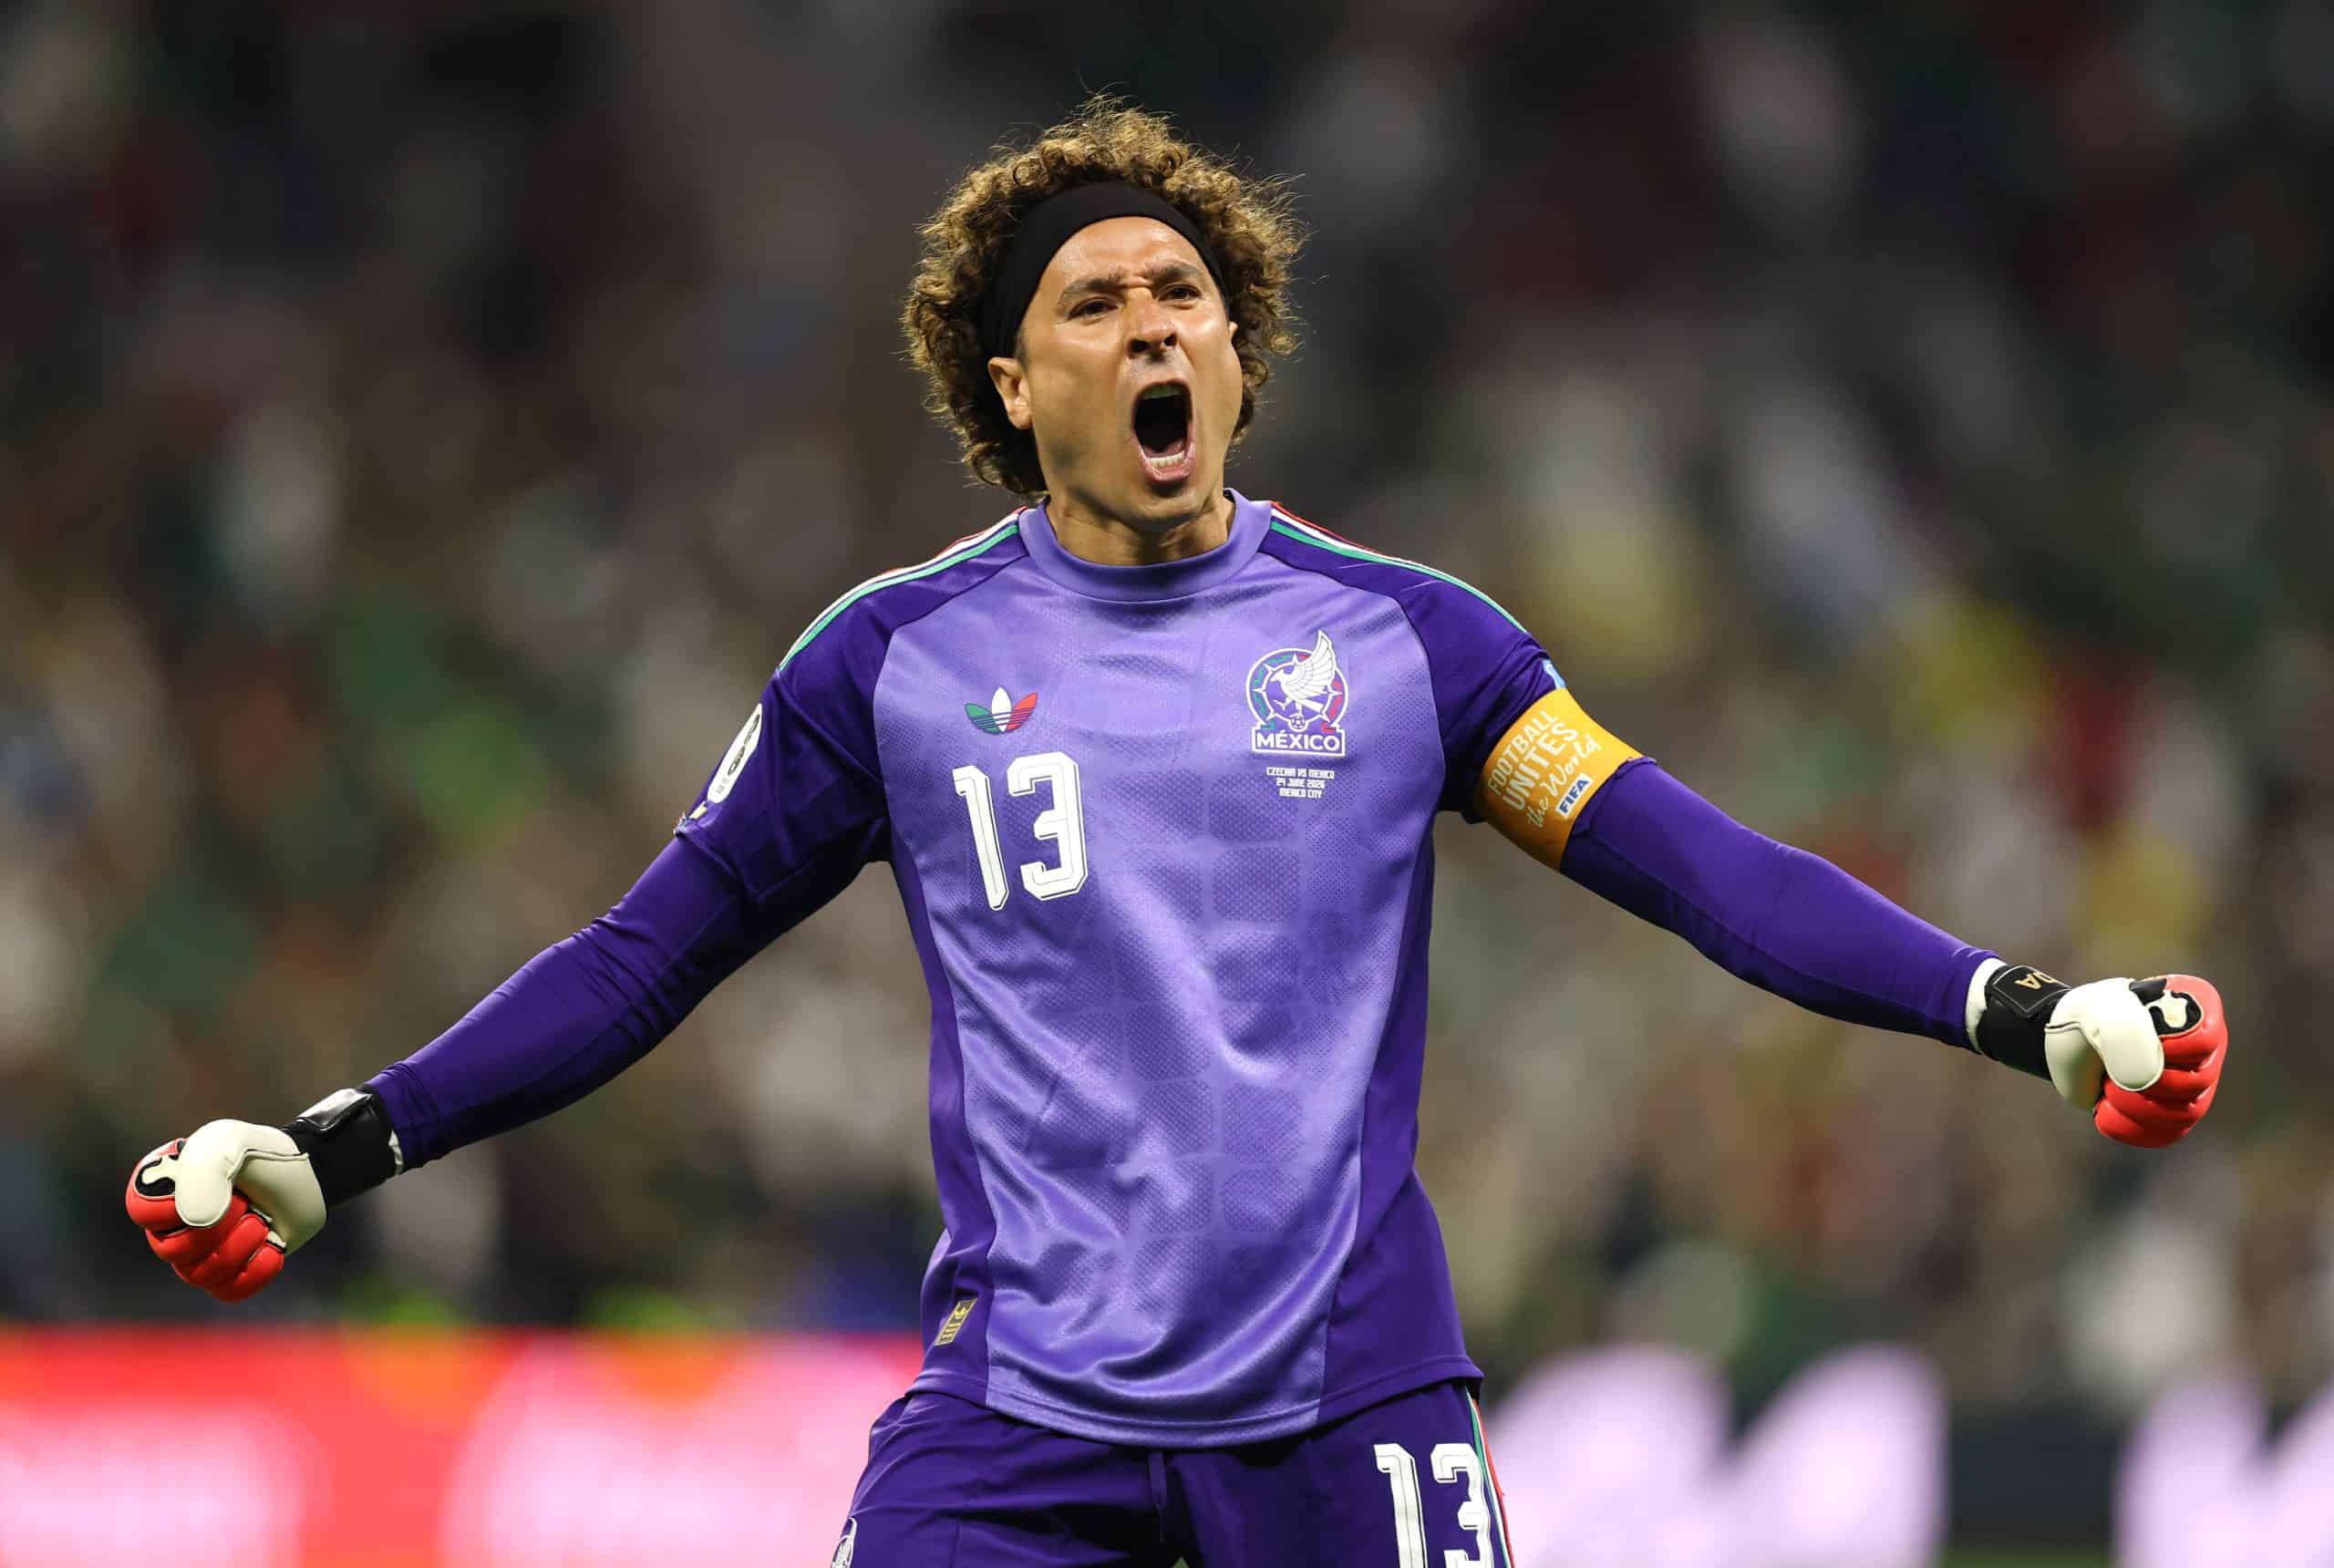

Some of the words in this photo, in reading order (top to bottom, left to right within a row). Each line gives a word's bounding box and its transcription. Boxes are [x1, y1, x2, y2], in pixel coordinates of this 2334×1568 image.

[1256, 729, 1340, 751] MÉXICO
[1487, 710, 1562, 796] FOOTBALL
[1503, 722, 1579, 810] UNITES
[1266, 767, 1296, 777] CZECHIA
[1297, 768, 1306, 778] VS
[1308, 769, 1335, 779] MEXICO
[1276, 777, 1286, 787] 24
[1280, 788, 1306, 798] MEXICO
[1307, 789, 1322, 799] CITY
[1526, 795, 1552, 828] the
[1542, 734, 1604, 797] World
[1559, 778, 1590, 814] FIFA
[953, 751, 1089, 911] 13
[1373, 1443, 1494, 1568] 13
